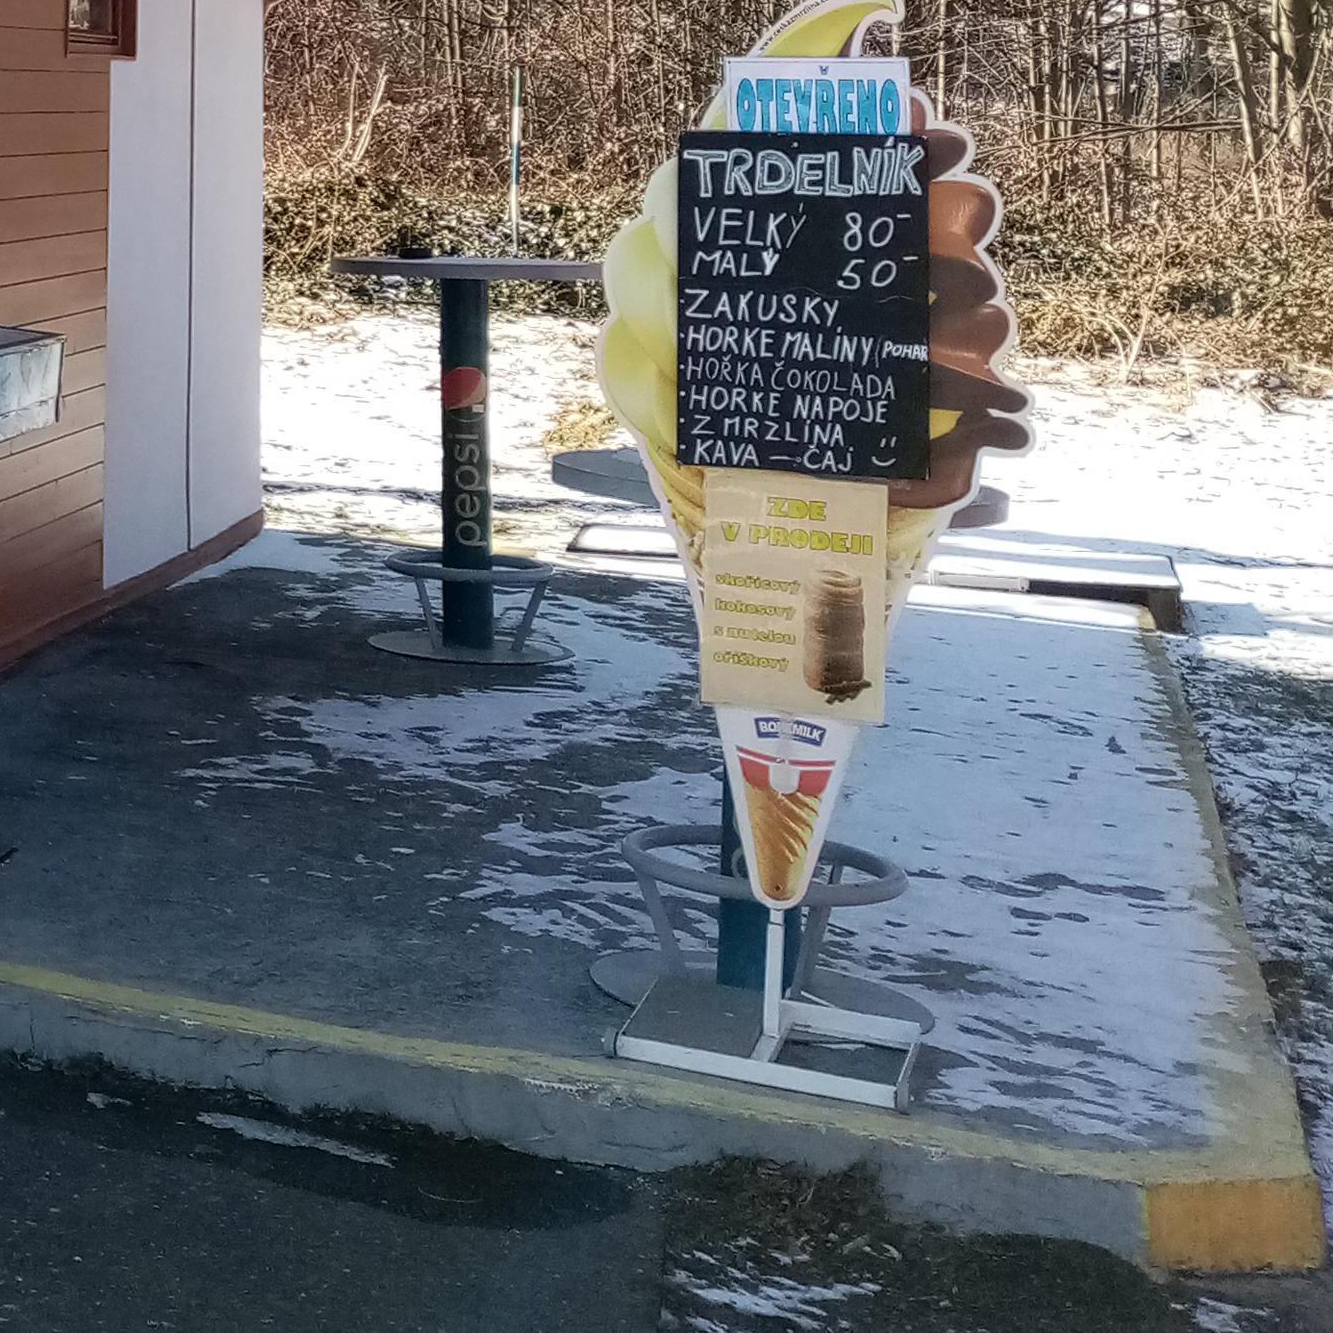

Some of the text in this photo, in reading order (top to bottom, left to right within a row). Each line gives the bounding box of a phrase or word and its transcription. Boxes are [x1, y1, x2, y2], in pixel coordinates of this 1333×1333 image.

[737, 66, 900, 134] OTEVŘENO
[683, 137, 925, 198] TRDELNÍK
[694, 202, 807, 249] VELKÝ
[686, 324, 775, 357] HORKE
[686, 354, 896, 400] HOŘKA ČOKOLADA
[689, 385, 889, 423] HORKE NAPOJE
[694, 439, 760, 467] KAVA
[447, 432, 488, 548] pepsi
[767, 496, 827, 521] ZDE
[720, 521, 874, 556] V PRODEJI
[713, 625, 724, 636] s
[758, 720, 825, 742] BOMILK
